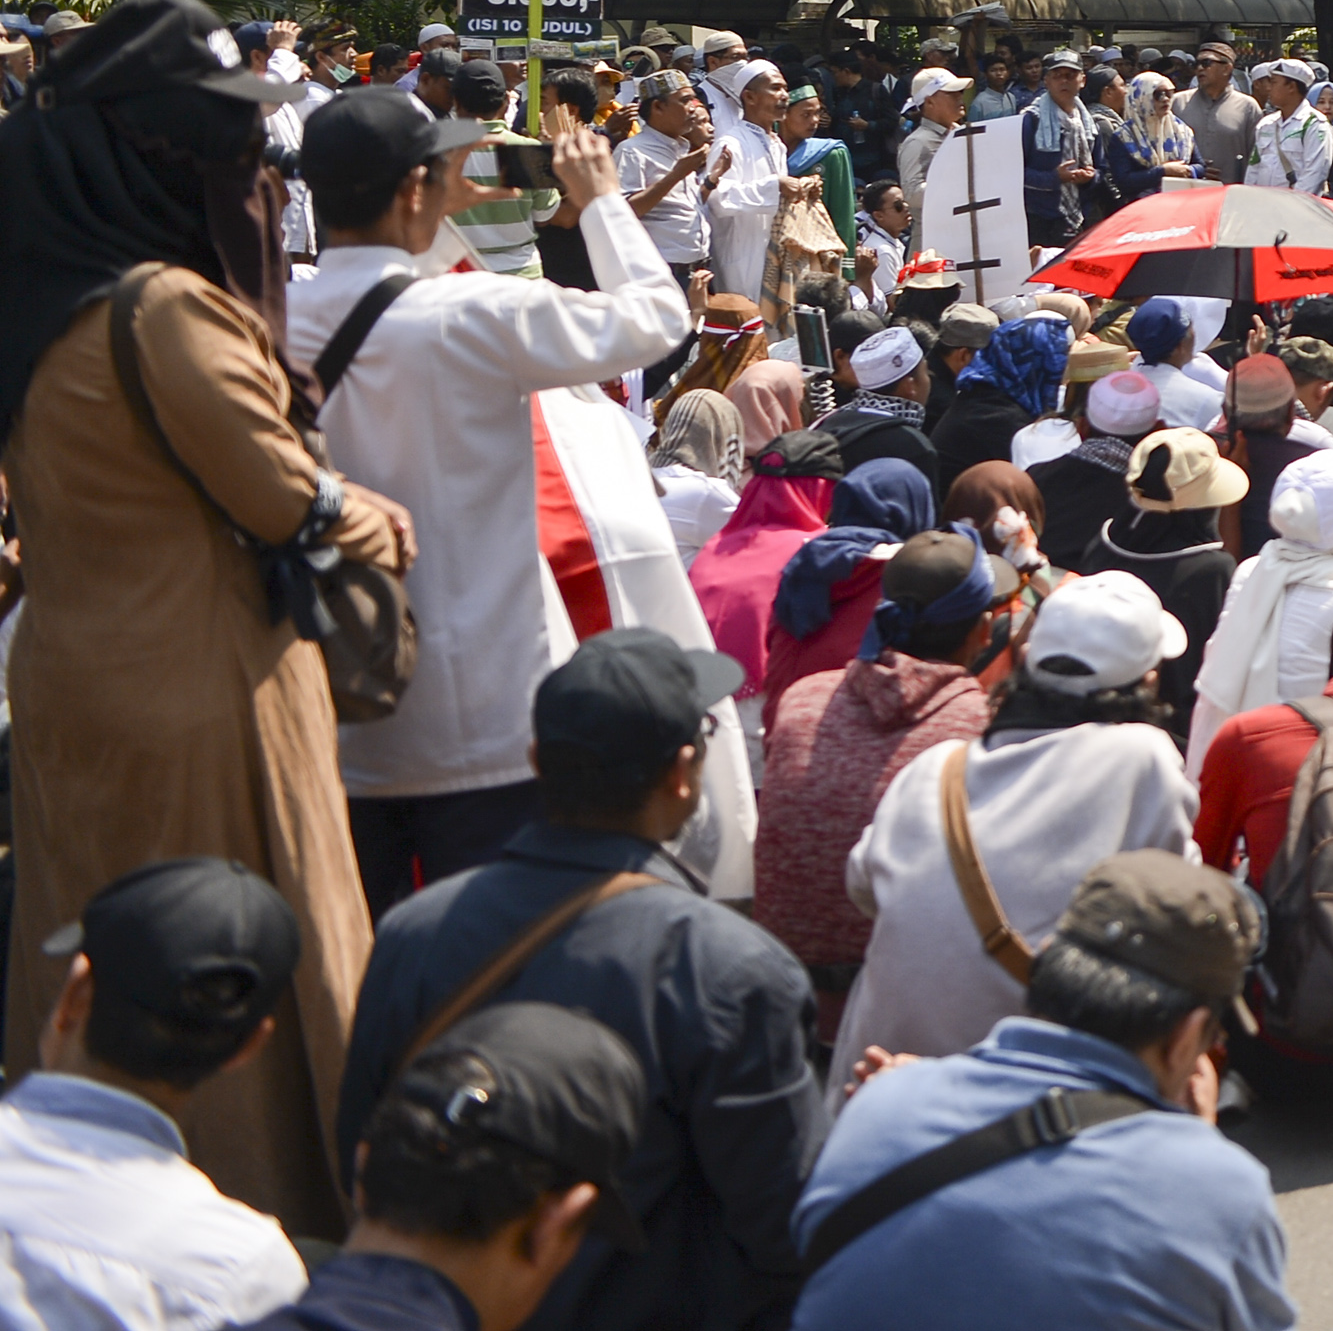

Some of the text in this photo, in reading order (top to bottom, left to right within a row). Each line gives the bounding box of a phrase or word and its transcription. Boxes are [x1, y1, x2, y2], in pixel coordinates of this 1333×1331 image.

[467, 18, 592, 36] (ISI 10 UDUL)
